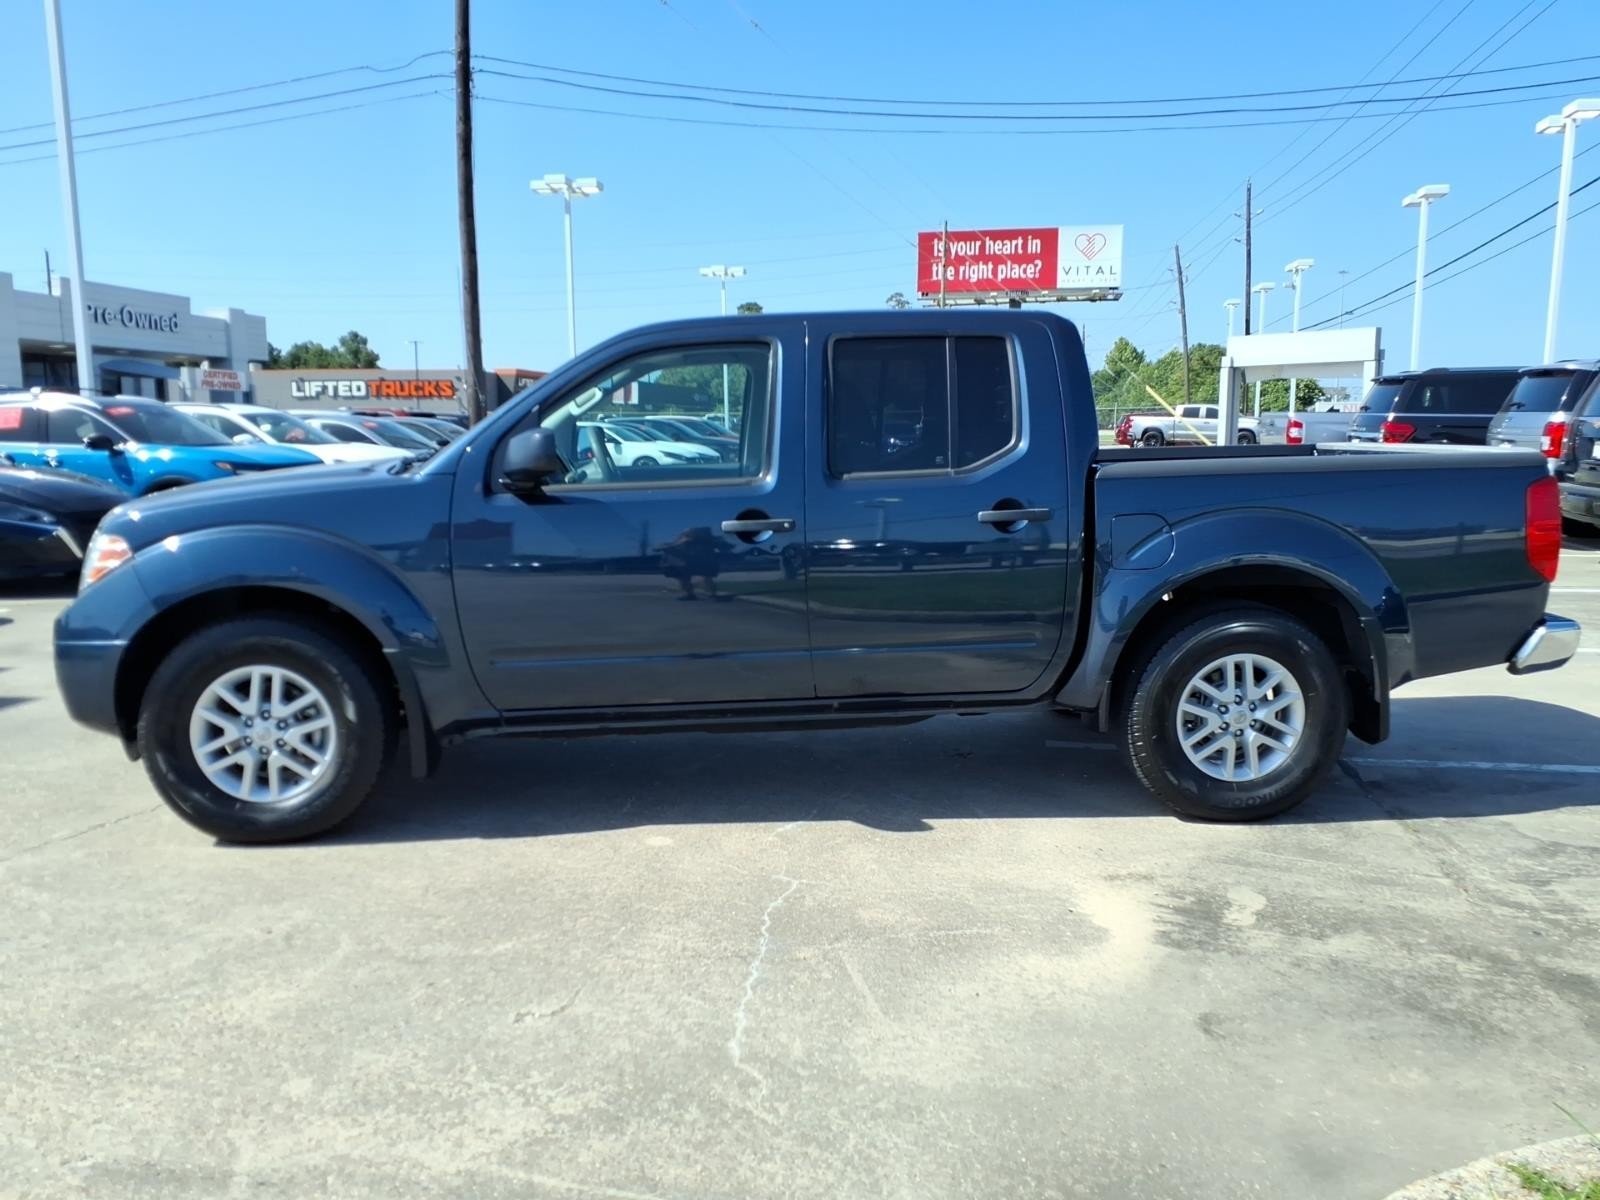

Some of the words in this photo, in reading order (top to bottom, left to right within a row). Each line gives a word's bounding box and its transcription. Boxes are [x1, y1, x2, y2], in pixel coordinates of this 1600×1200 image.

[933, 238, 945, 256] Is
[950, 240, 981, 259] your
[985, 236, 1023, 255] heart
[1027, 235, 1041, 254] in
[959, 261, 993, 282] right
[997, 259, 1042, 281] place?
[1062, 265, 1117, 276] VITAL
[291, 380, 367, 398] LIFTED
[367, 380, 456, 398] TRUCKS
